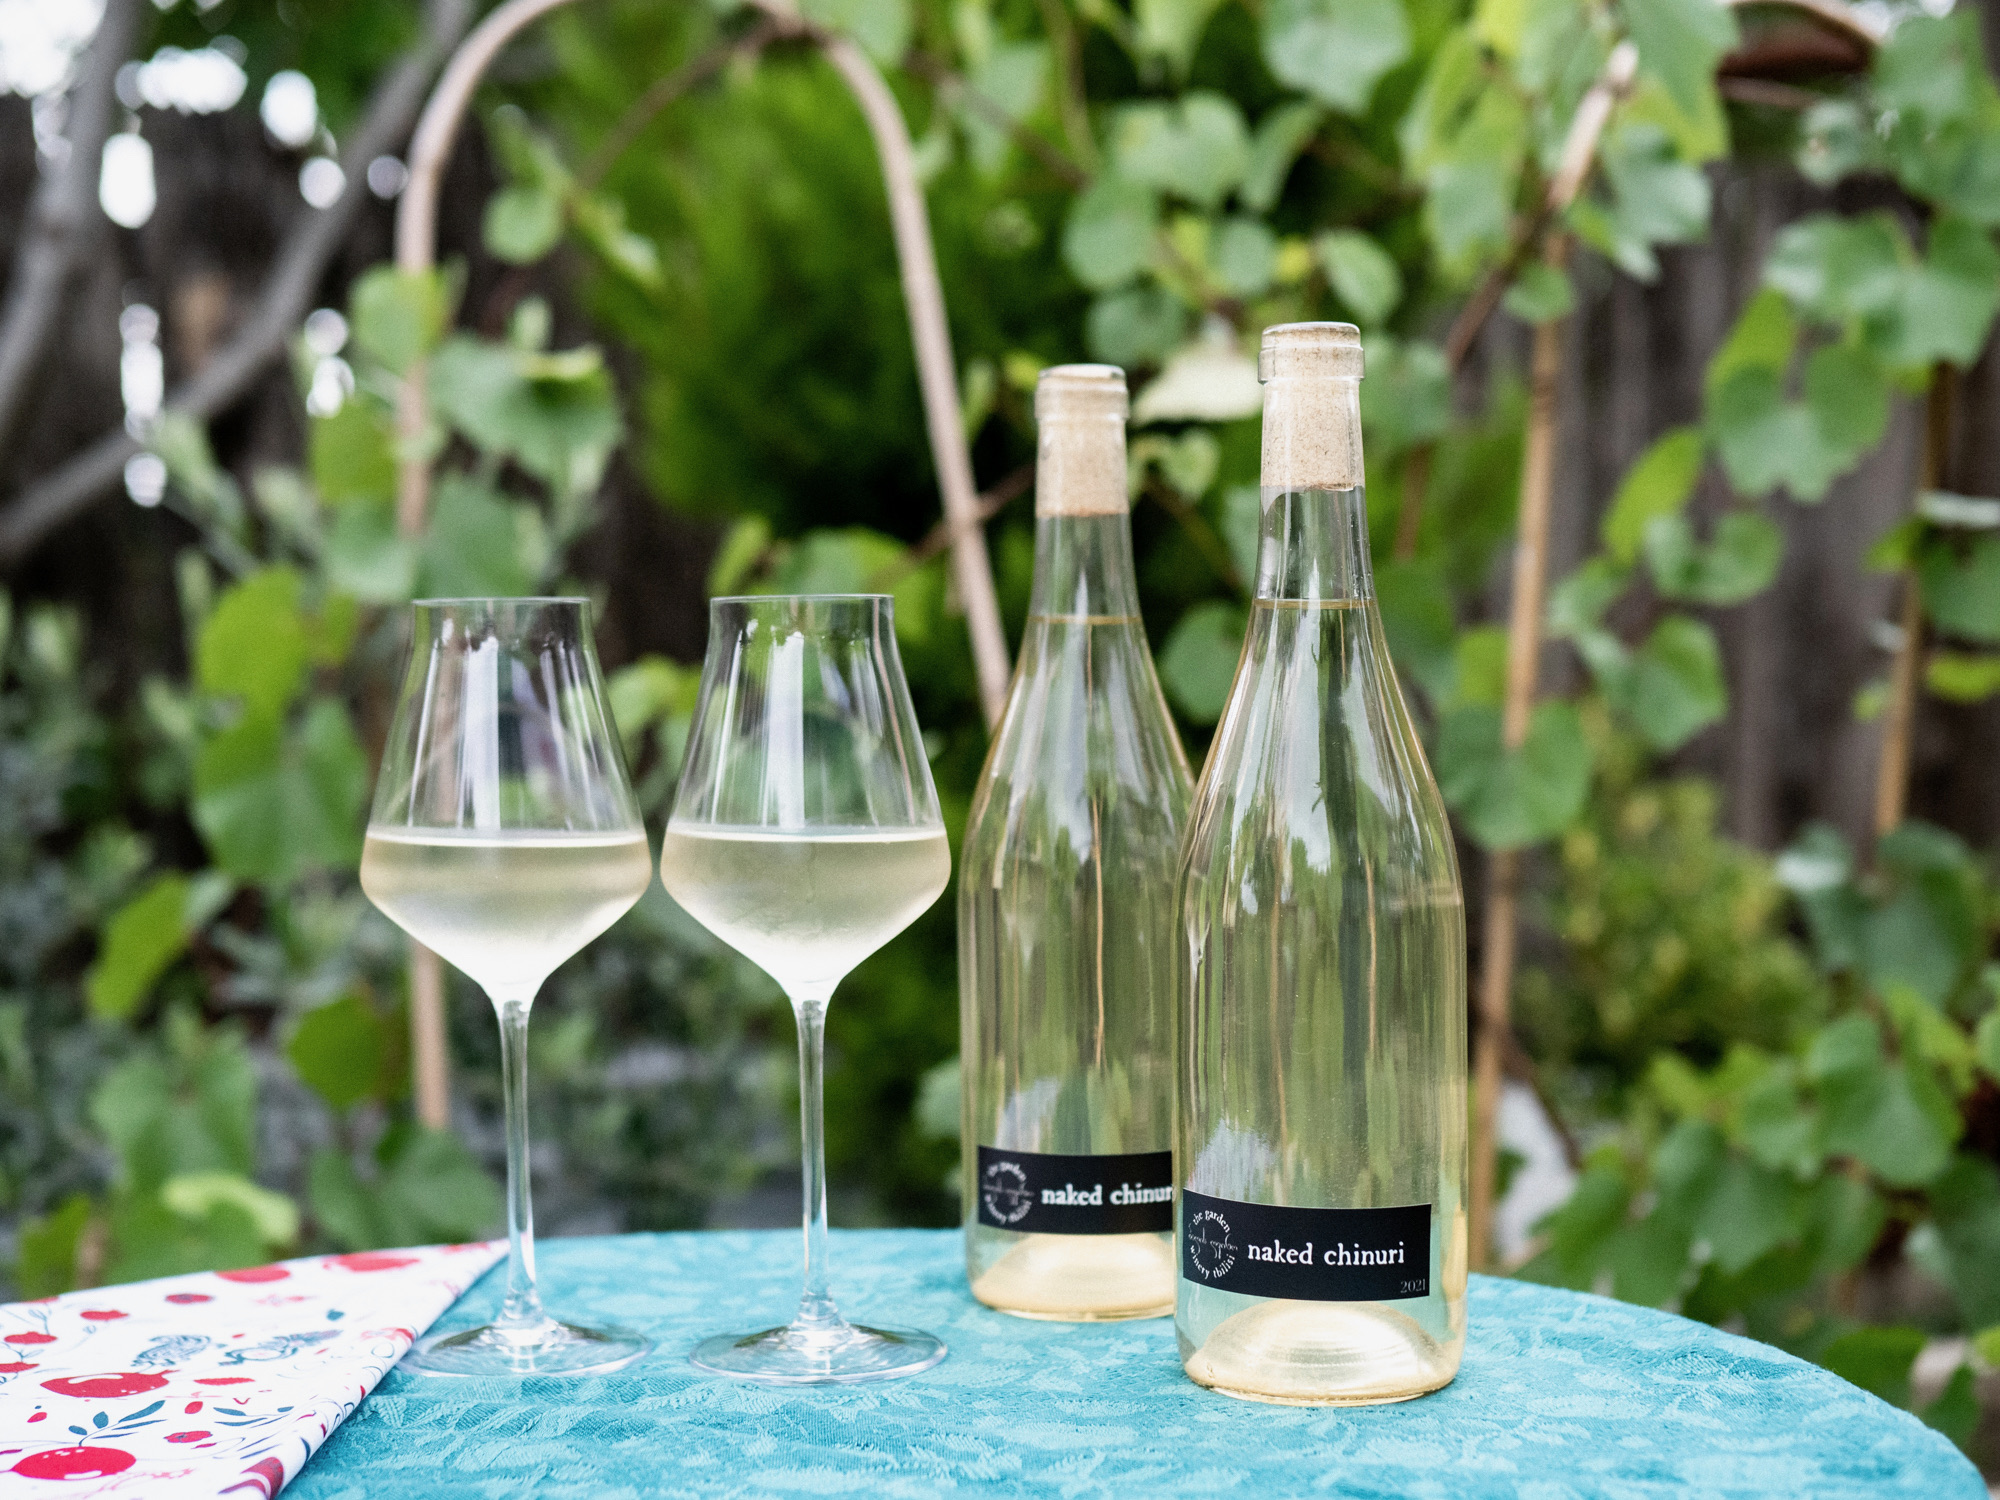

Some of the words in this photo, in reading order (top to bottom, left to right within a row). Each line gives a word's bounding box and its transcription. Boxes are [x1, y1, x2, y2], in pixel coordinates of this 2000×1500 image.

[1041, 1183, 1103, 1206] naked
[1109, 1182, 1174, 1206] chinur
[1193, 1212, 1203, 1226] the
[1204, 1210, 1231, 1234] garden
[1190, 1244, 1210, 1280] winery
[1212, 1253, 1236, 1279] tbilisi
[1247, 1239, 1314, 1265] naked
[1324, 1241, 1405, 1266] chinuri
[1400, 1278, 1426, 1294] 2021
